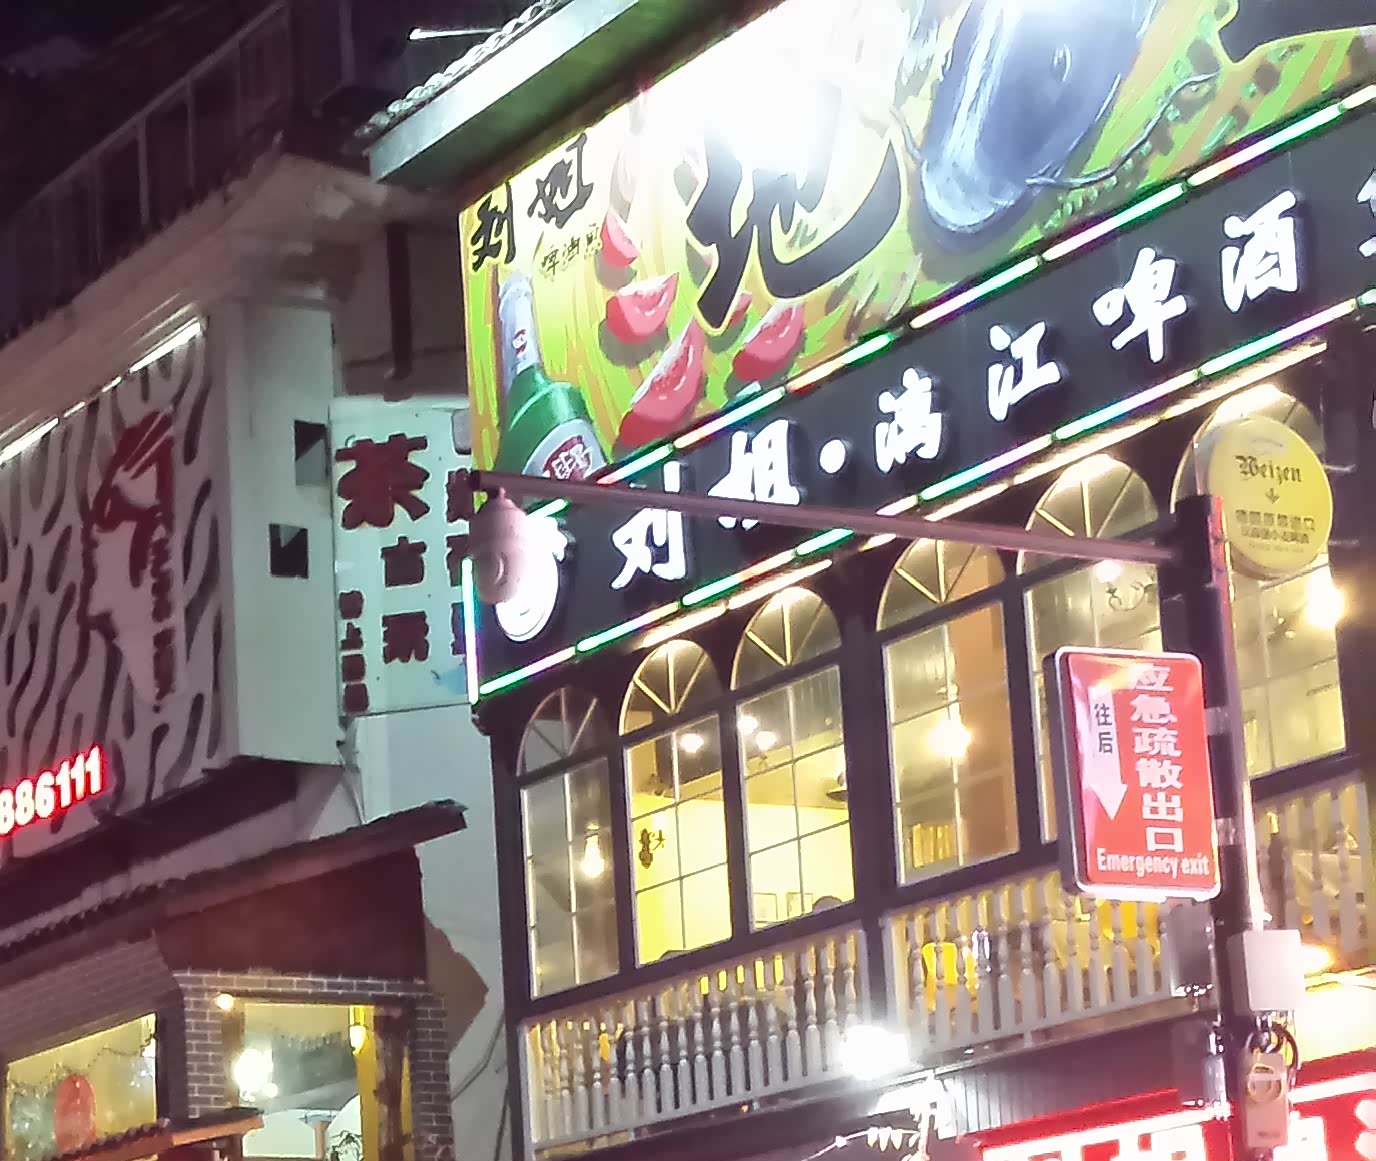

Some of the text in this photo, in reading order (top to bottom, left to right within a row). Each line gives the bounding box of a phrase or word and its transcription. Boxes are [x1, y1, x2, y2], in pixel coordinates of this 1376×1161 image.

[1234, 455, 1302, 485] Weizen
[1094, 702, 1114, 755] 往后
[1127, 662, 1184, 852] 应急疏散出口
[1096, 847, 1210, 879] Emergency exit
